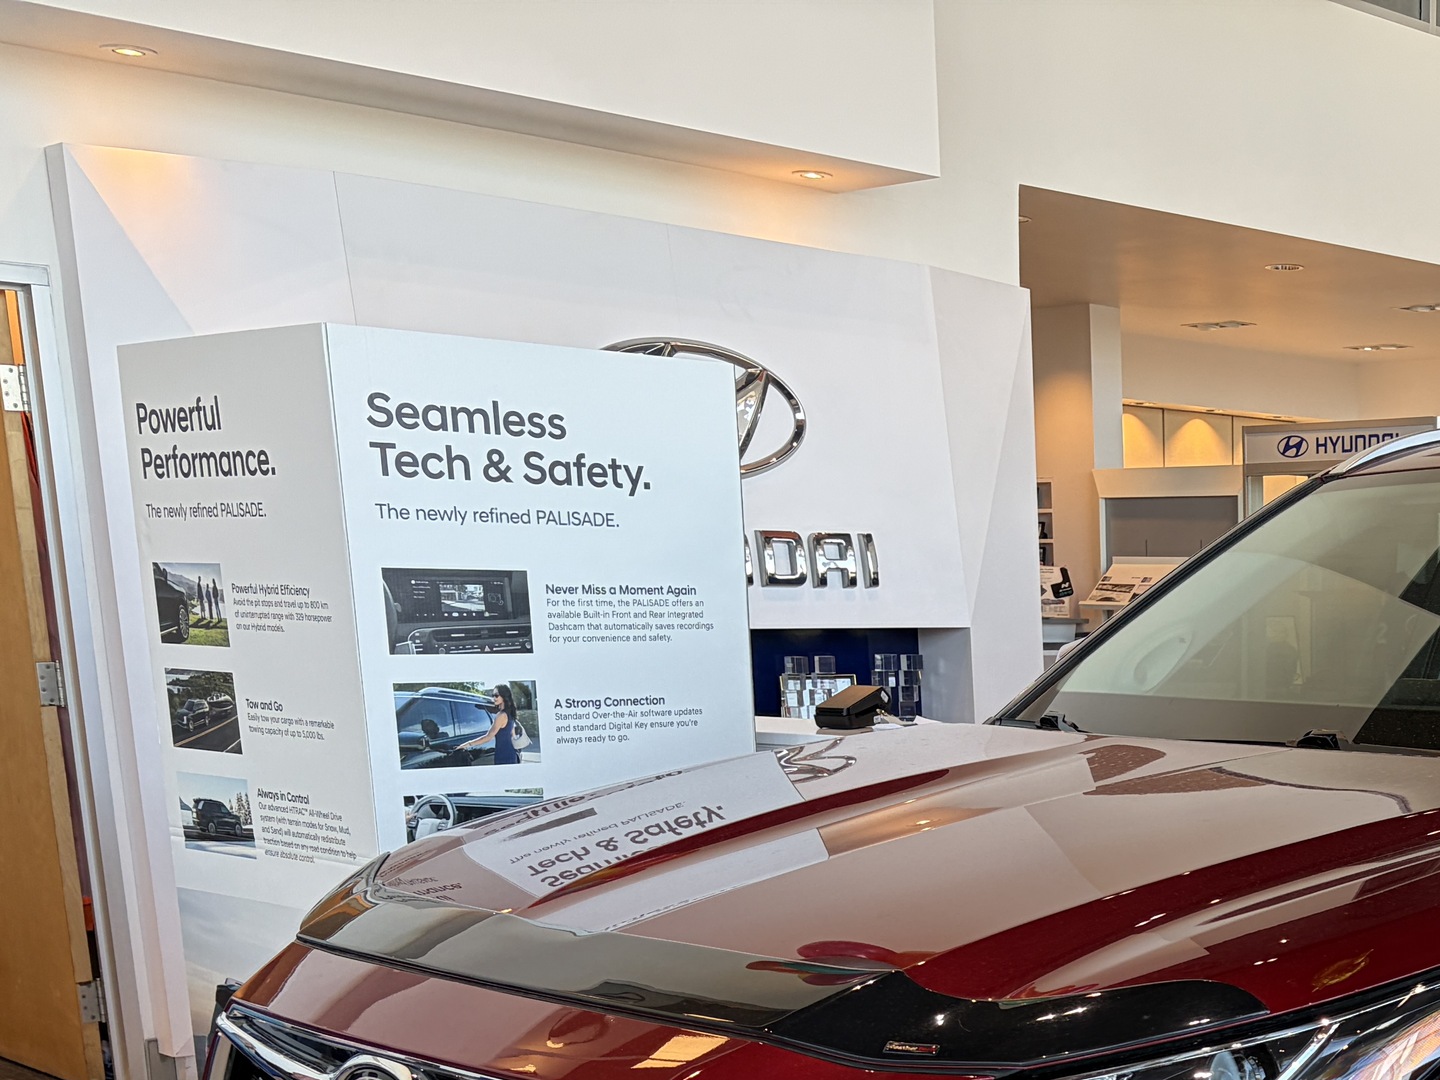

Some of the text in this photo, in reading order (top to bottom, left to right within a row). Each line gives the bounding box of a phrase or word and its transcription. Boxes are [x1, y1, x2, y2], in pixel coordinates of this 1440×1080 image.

[136, 395, 222, 435] Powerful
[367, 392, 567, 440] Seamless
[1316, 433, 1399, 454] HYUND
[141, 445, 276, 480] Performance.
[369, 441, 651, 497] Tech & Safety.
[146, 502, 267, 521] The newly refined PALISADE.
[375, 503, 620, 528] The newly refined PALISADE.
[232, 583, 310, 598] Powerful Hybrid Efficiency
[545, 584, 696, 597] Never Miss a Moment Again
[547, 599, 559, 607] For
[562, 599, 575, 607] the
[578, 598, 593, 607] first
[595, 599, 616, 608] time,
[618, 598, 630, 607] the
[632, 599, 670, 607] PALISADE
[672, 599, 693, 607] offers
[547, 610, 704, 620] available Built-in Front and Rear Integrated
[549, 623, 585, 631] Dashcam
[587, 623, 602, 631] that
[604, 623, 653, 632] automatically
[676, 622, 714, 631] recordings
[549, 634, 672, 644] for your convenience and safety.
[245, 699, 283, 712] Tow and Go
[554, 695, 665, 710] A Strong Connection
[555, 707, 703, 721] Standard Over-the-Air software updates
[556, 724, 571, 733] and
[573, 722, 607, 732] standard
[609, 721, 633, 732] Digital
[635, 721, 648, 730] Key
[676, 720, 699, 729] you're
[557, 736, 583, 745] always
[585, 735, 606, 744] ready
[618, 734, 630, 743] go.
[257, 788, 310, 805] Always in Control
